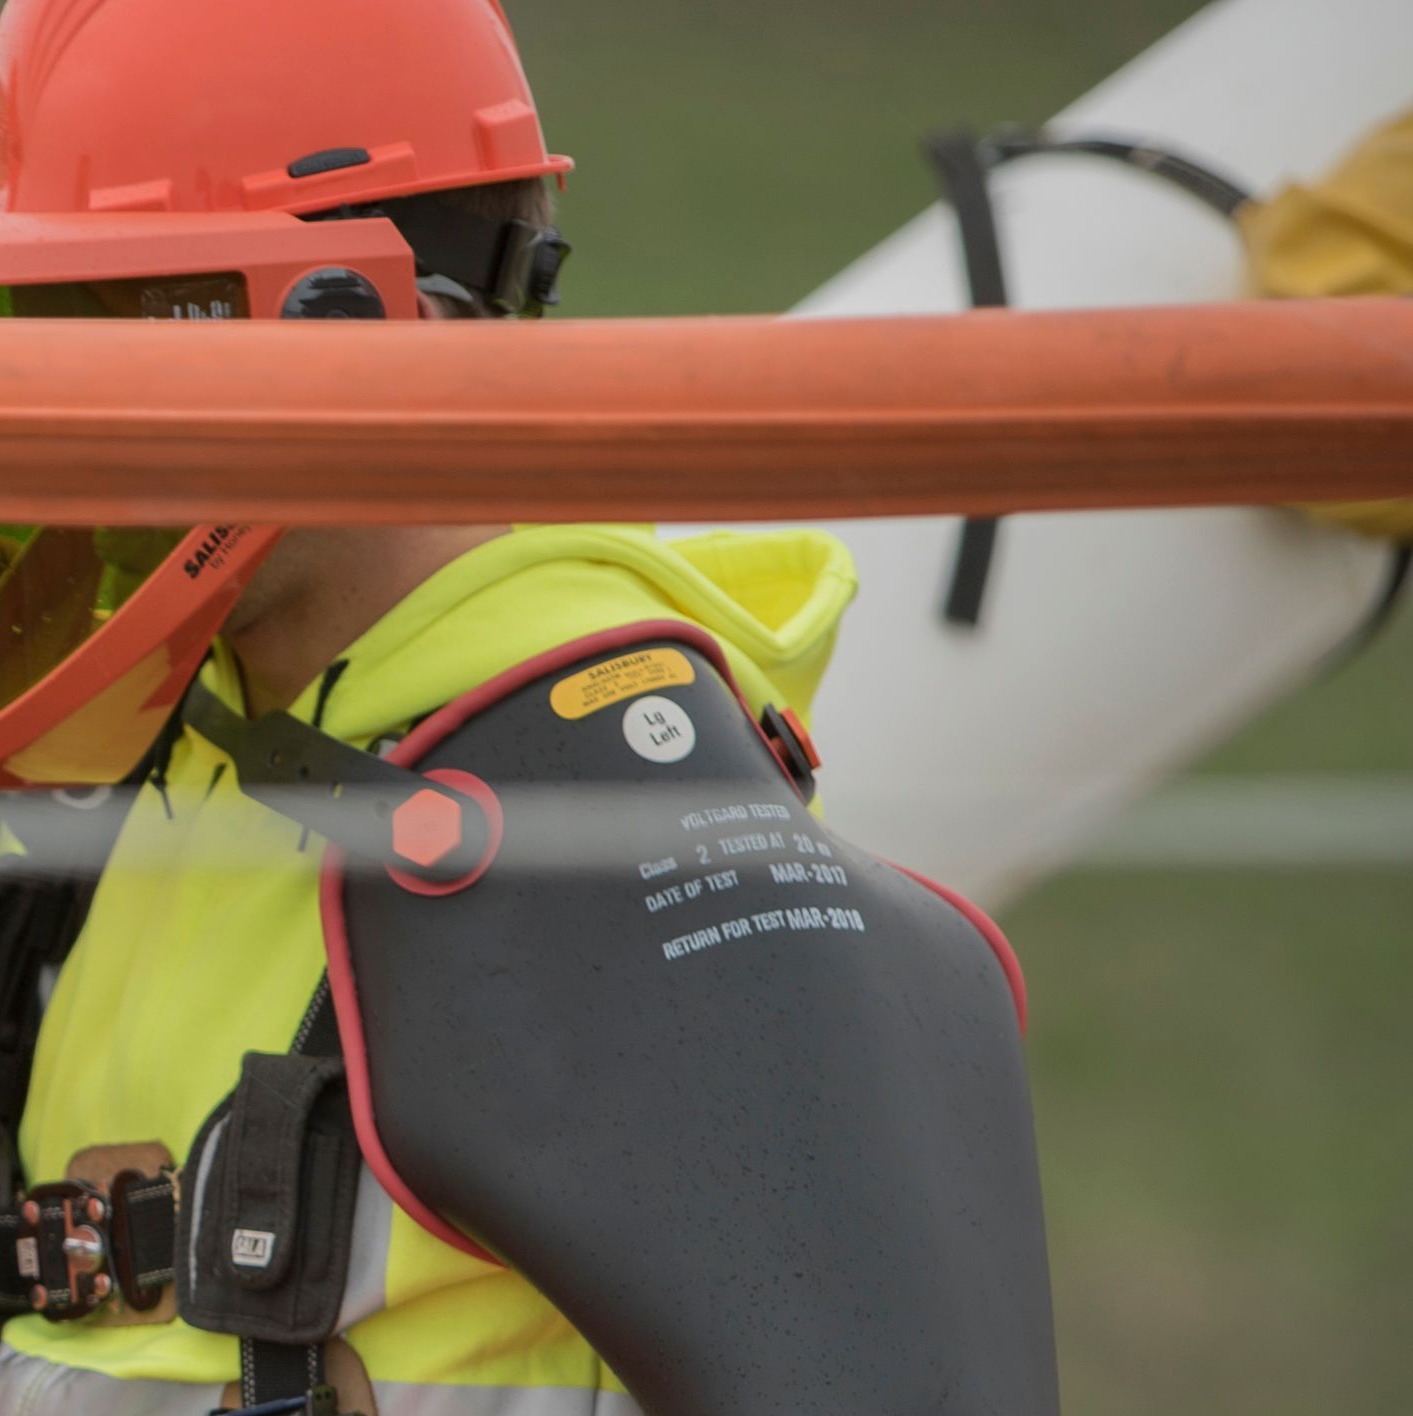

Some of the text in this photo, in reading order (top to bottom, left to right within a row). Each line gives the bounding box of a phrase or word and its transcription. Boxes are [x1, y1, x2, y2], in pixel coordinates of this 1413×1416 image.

[184, 525, 234, 579] SALIS
[588, 653, 653, 680] SALISBURY
[643, 711, 666, 726] Lg
[650, 723, 681, 747] Left
[681, 804, 791, 831] VOLTGARD TESTED
[639, 857, 678, 880] Class
[696, 844, 711, 865] 2
[718, 832, 768, 855] TESTED
[769, 831, 786, 848] AT
[793, 833, 815, 853] 20
[645, 862, 848, 913] DATE OF TEST MAR-2017
[662, 906, 866, 961] RETURN FOR TEST MAR-2018
